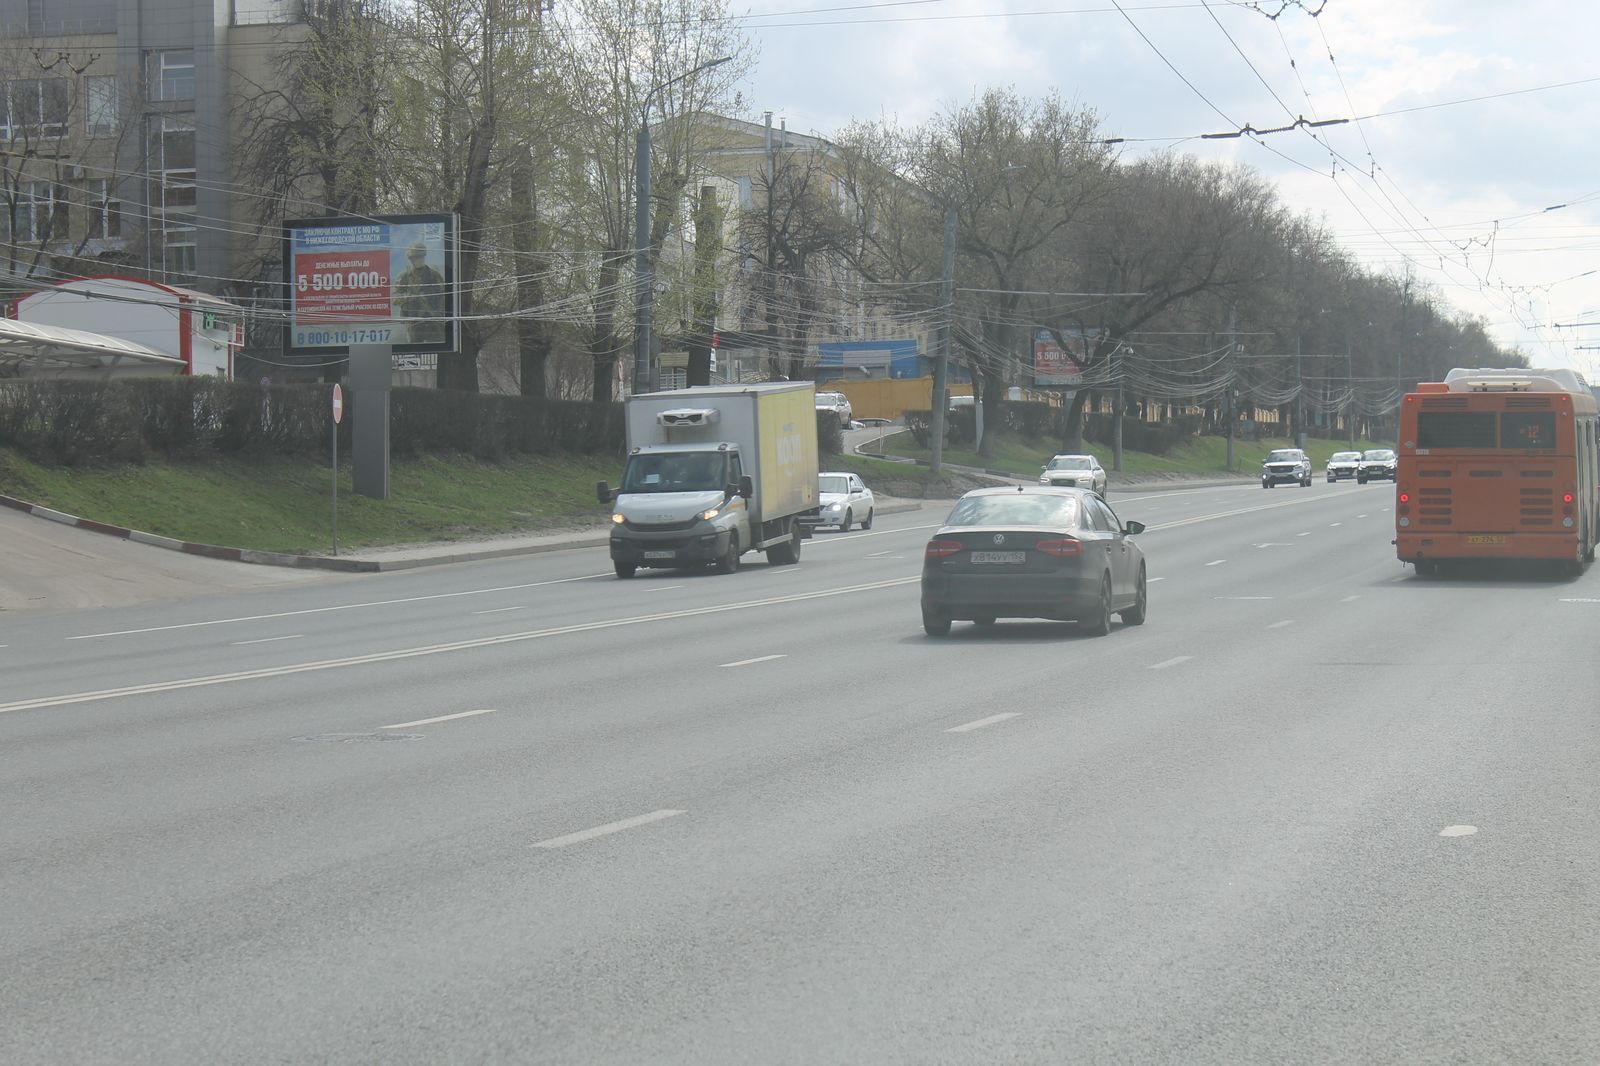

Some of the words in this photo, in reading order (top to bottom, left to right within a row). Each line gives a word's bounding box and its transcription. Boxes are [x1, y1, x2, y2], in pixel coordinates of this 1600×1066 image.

[331, 226, 356, 235] КОНТРАКТ
[362, 226, 370, 234] МО
[371, 225, 380, 233] РФ
[310, 235, 355, 244] НИЖЕГОРОДСКОЙ
[356, 234, 380, 243] ОБЛАСТИ
[315, 261, 340, 269] ДЕНЕЖНЫЕ
[341, 260, 362, 268] ВЫПЛАТЫ
[363, 259, 370, 267] ДО
[298, 274, 308, 292] 5
[312, 272, 343, 291] 500
[297, 332, 305, 346] 8
